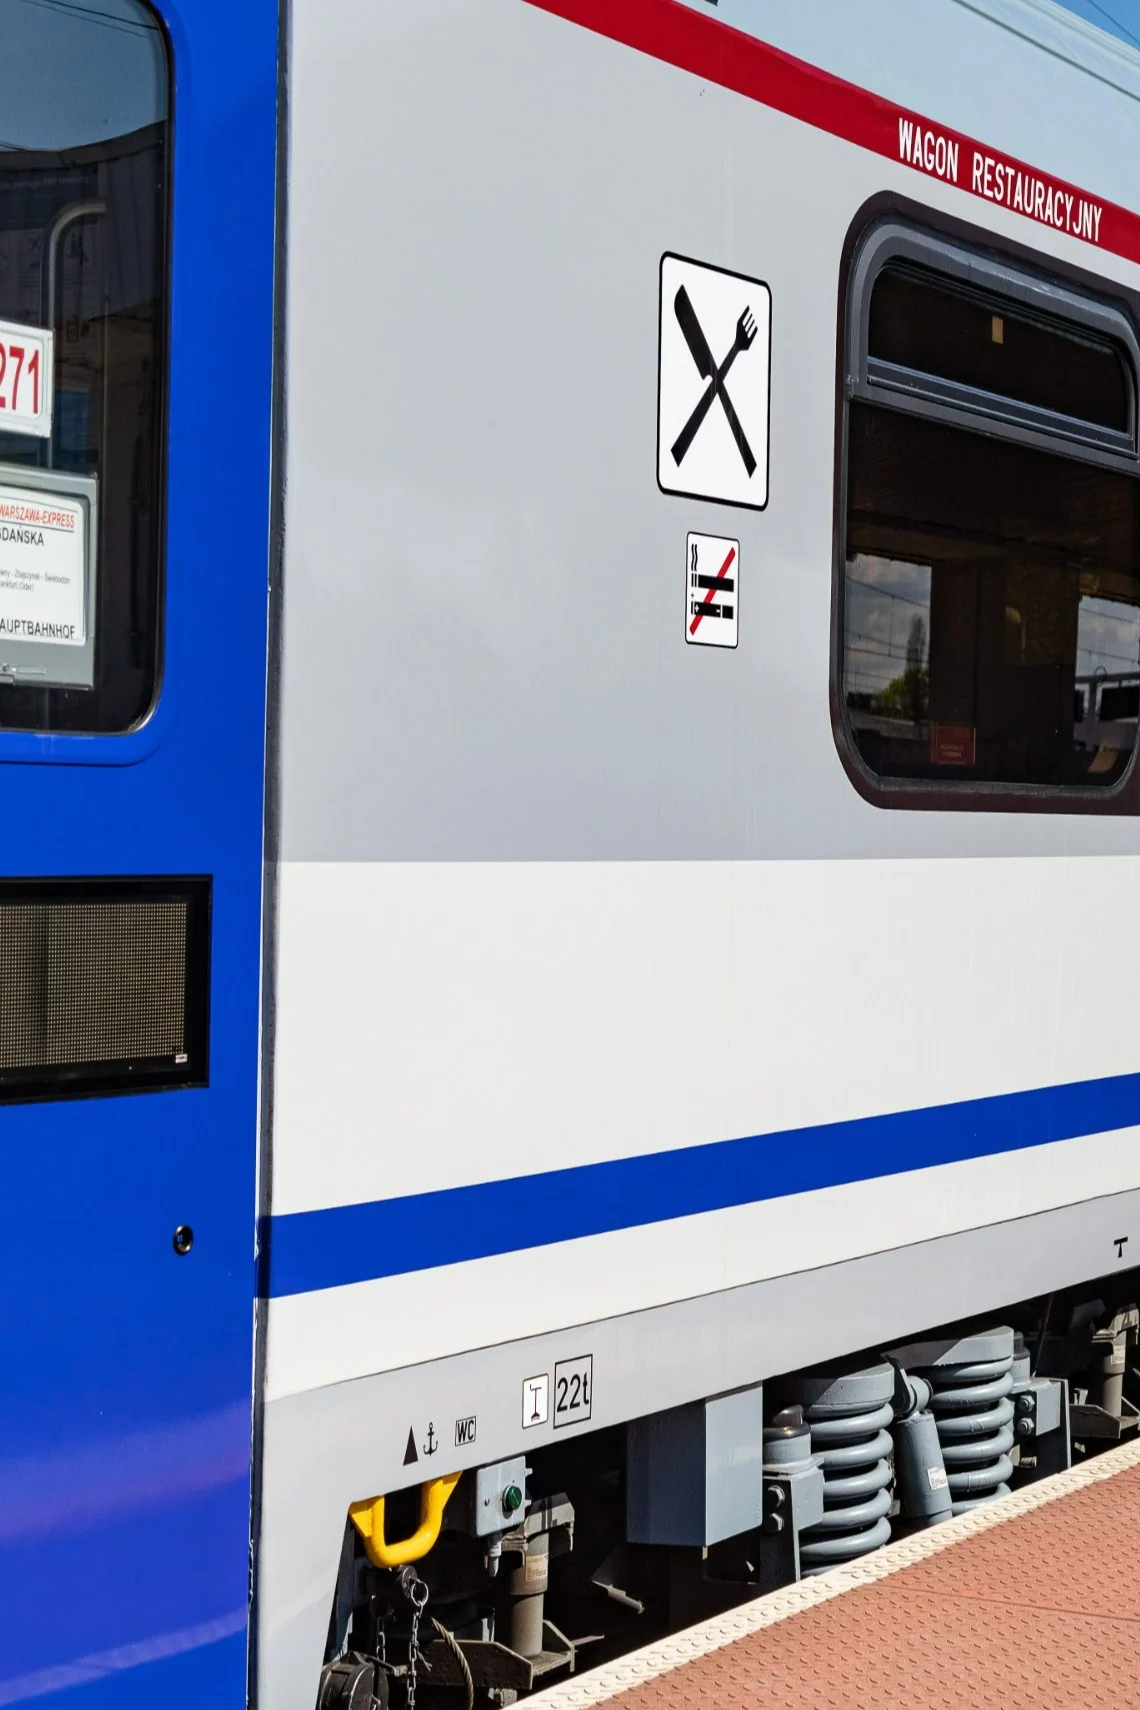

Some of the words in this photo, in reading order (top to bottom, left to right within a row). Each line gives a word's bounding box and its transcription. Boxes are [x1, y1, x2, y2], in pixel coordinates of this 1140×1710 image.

[898, 117, 959, 182] WAGON
[972, 151, 1102, 242] RESTAURACYJNY
[0, 526, 45, 546] DAŃSKA
[557, 1371, 590, 1413] 22t
[457, 1419, 475, 1443] WC
